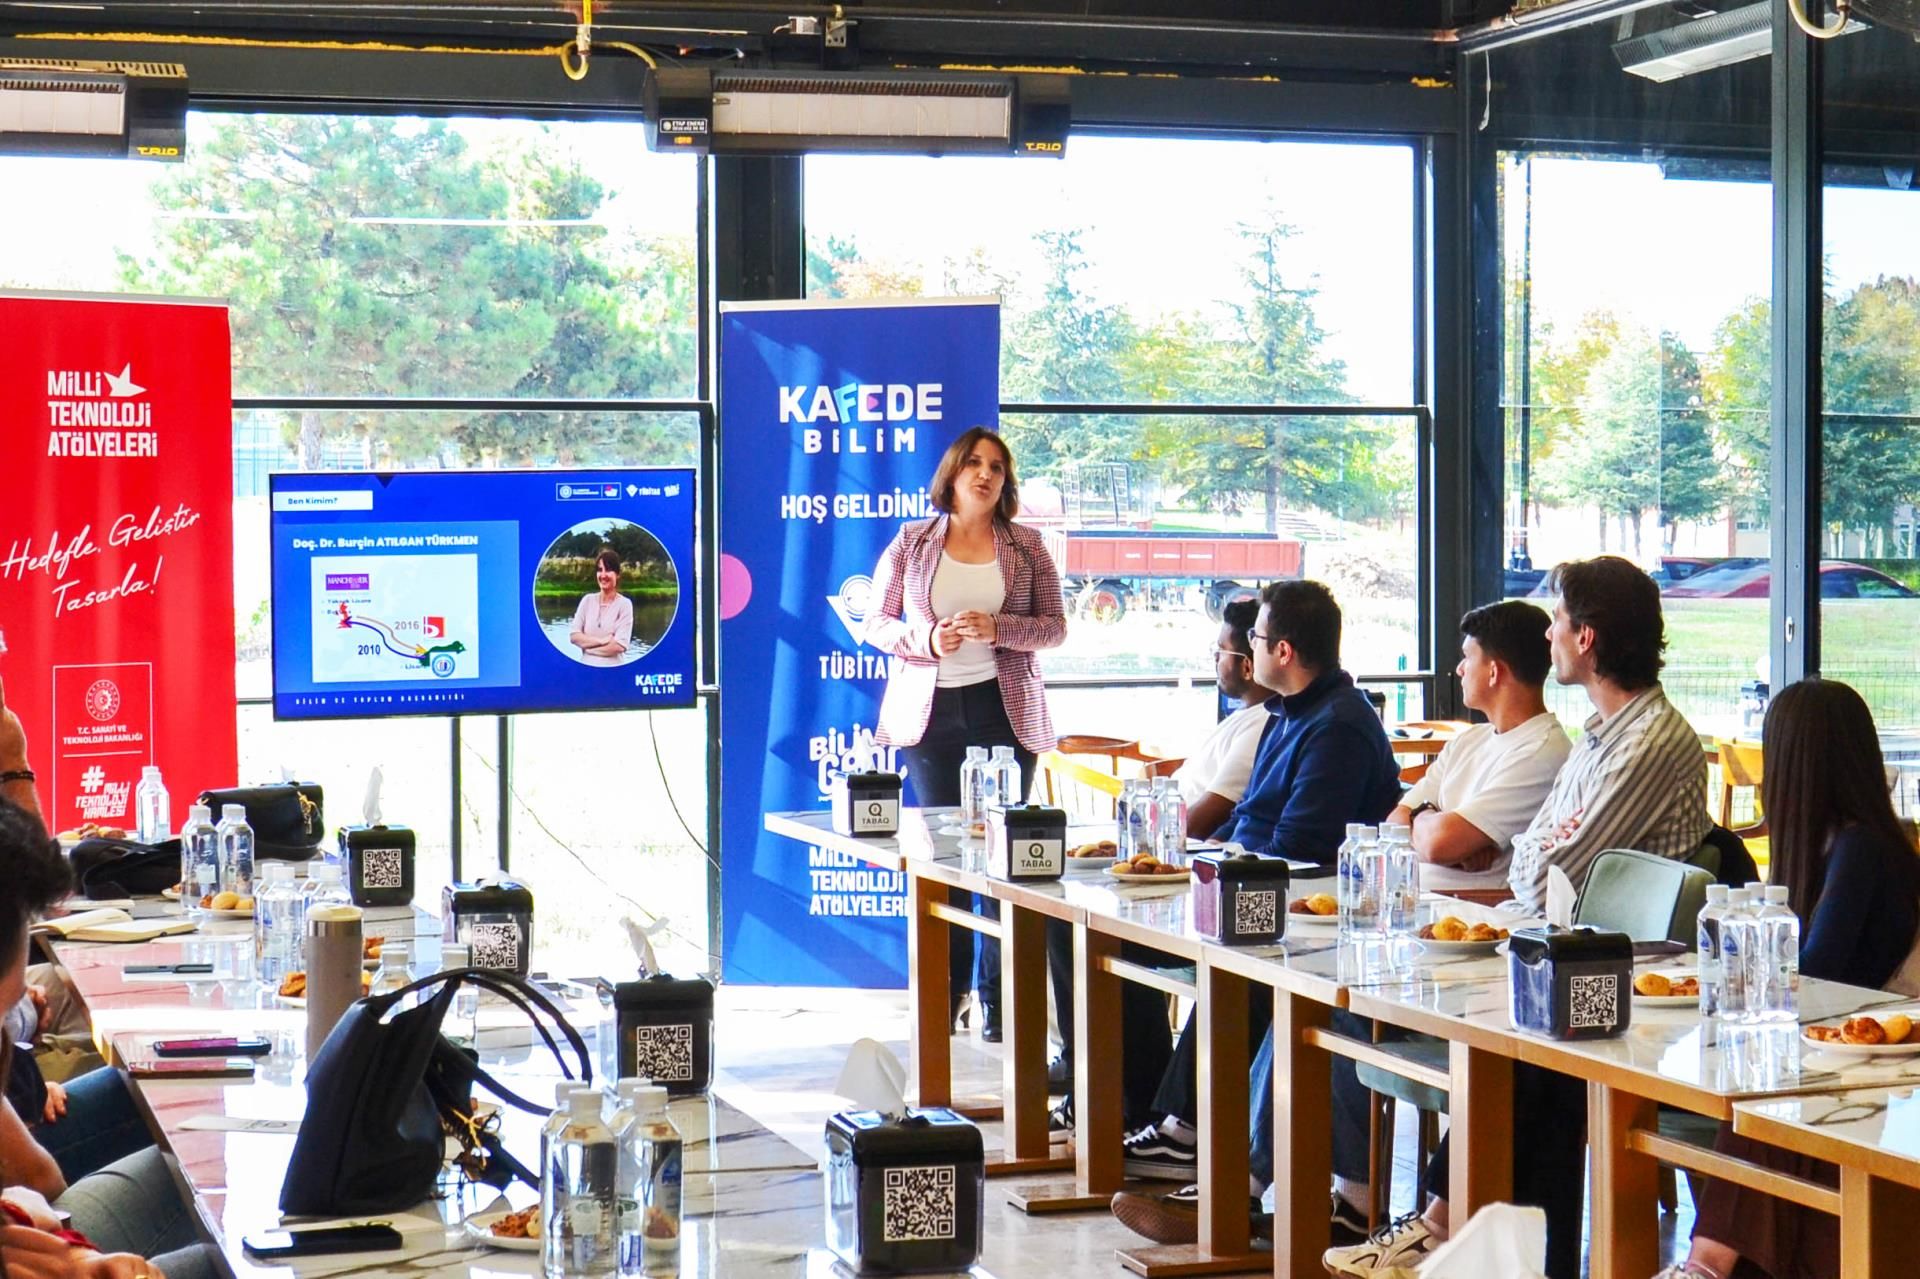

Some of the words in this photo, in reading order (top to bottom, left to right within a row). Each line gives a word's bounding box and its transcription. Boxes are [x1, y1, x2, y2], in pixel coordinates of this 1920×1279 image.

[779, 383, 943, 424] KAFEDE
[803, 427, 915, 454] BİLİM
[288, 497, 304, 505] Ben
[305, 496, 338, 505] Kimim?
[781, 495, 827, 524] HOŞ
[109, 503, 200, 547] Geliştir
[293, 538, 317, 551] Doç.
[319, 538, 336, 549] Dr.
[338, 536, 375, 550] Burçin
[376, 536, 424, 547] ATILGAN
[425, 533, 478, 546] TÜRKMEN
[52, 555, 163, 618] Tasarla!
[395, 621, 420, 631] 2016
[358, 645, 381, 656] 2010
[635, 674, 682, 687] KAFEDE
[117, 724, 127, 733] VE
[104, 732, 143, 743] BAKANLIĞI
[862, 816, 890, 825] TABAQ
[1020, 859, 1052, 868] TABAQ
